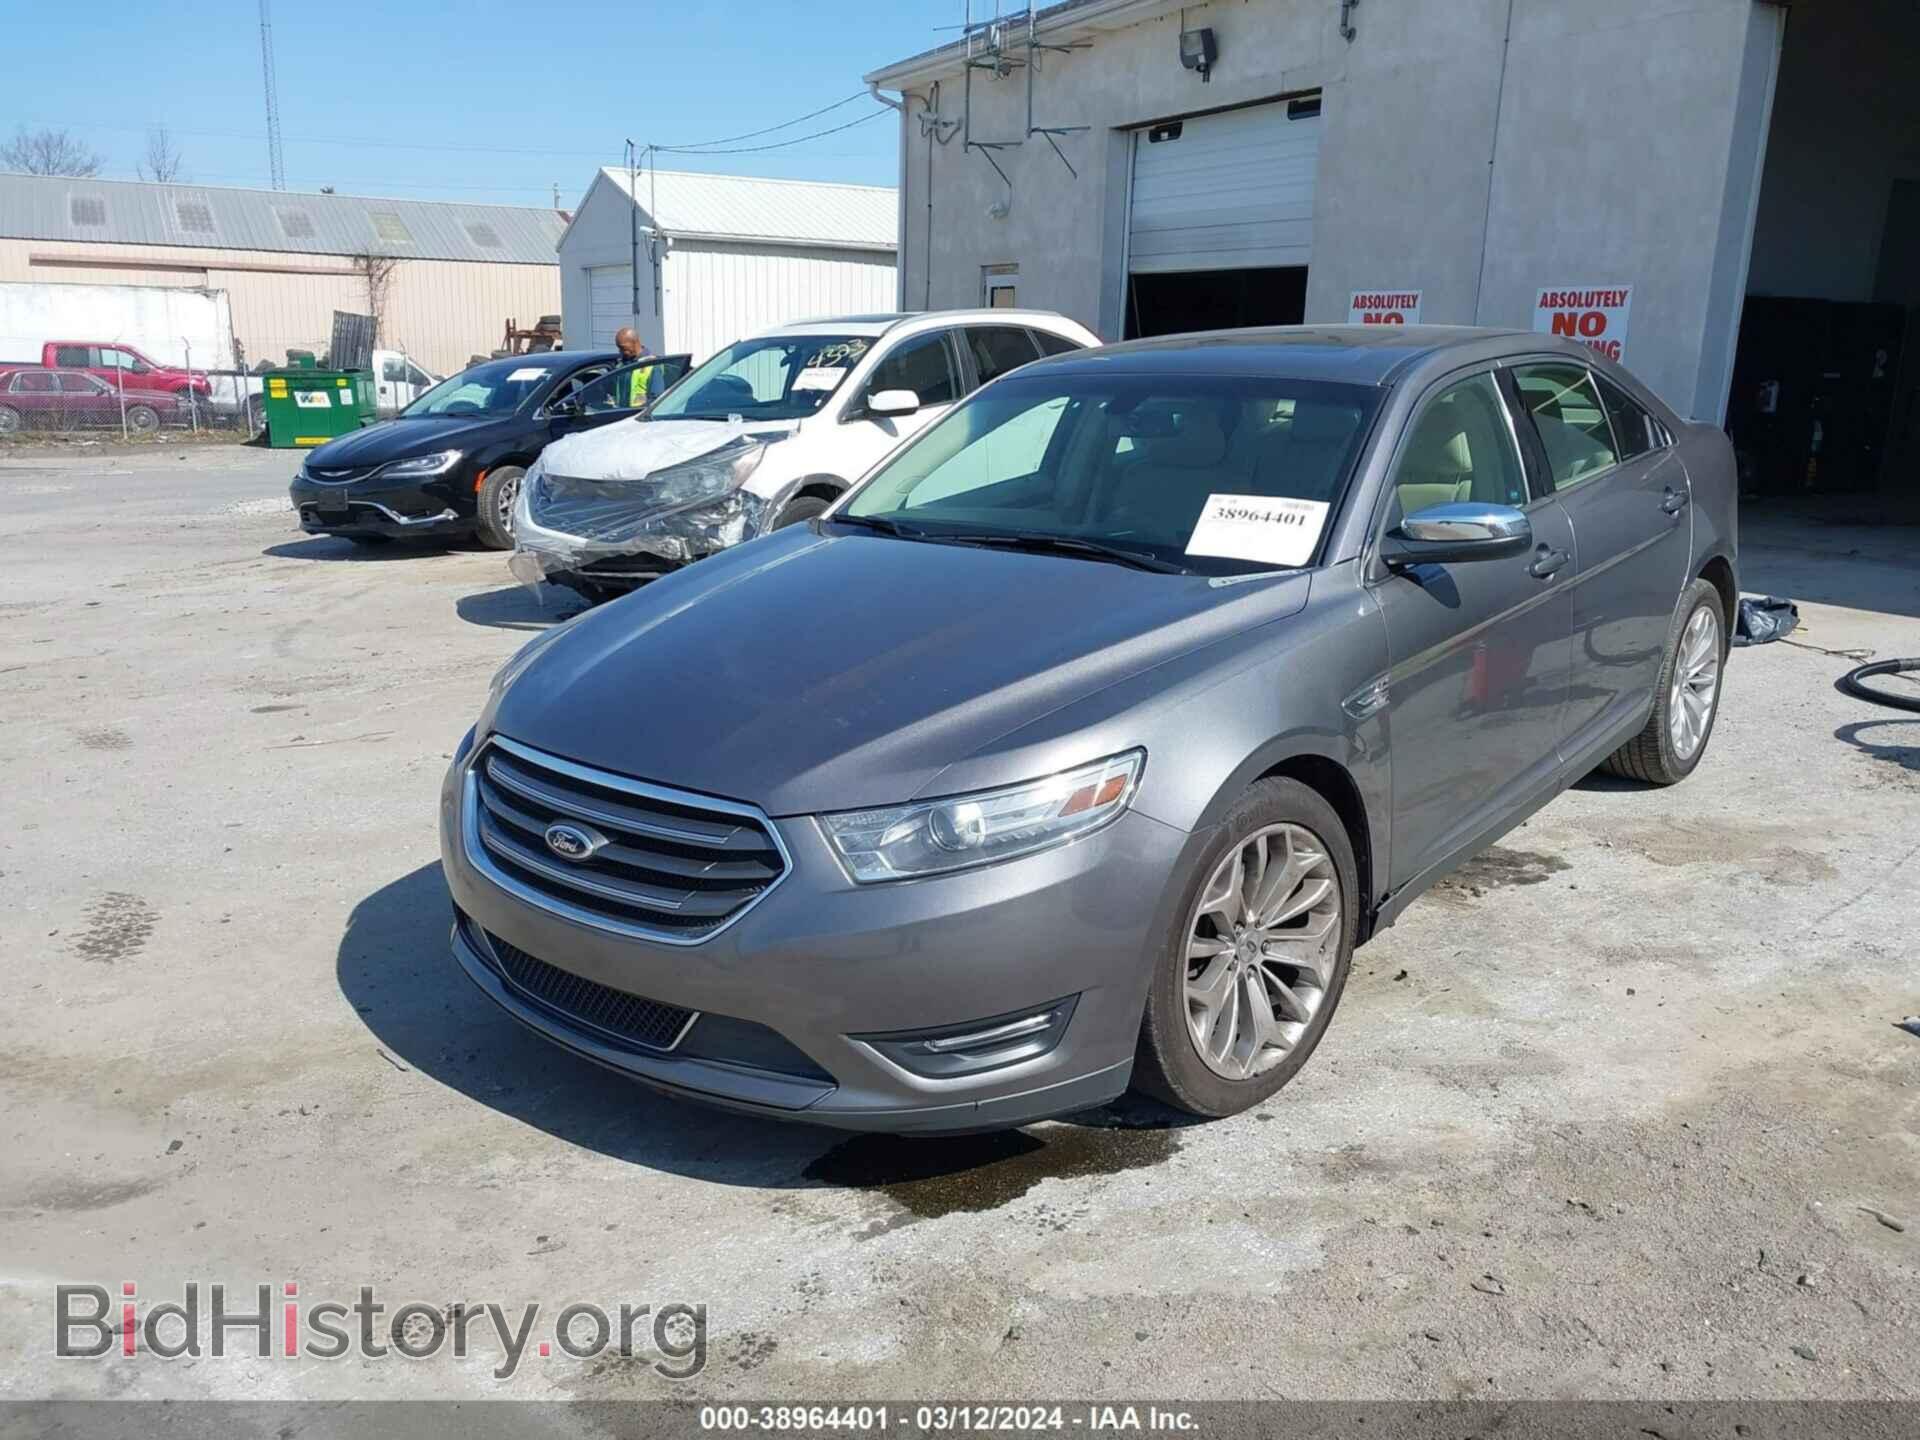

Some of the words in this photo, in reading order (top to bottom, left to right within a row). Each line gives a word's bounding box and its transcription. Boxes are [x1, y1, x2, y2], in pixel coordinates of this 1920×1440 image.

[1353, 294, 1418, 309] ABSOLUTELY
[1539, 290, 1628, 308] ABSOLUTELY
[1552, 311, 1607, 337] NO
[1211, 507, 1306, 526] 38964401
[552, 831, 578, 852] Ford
